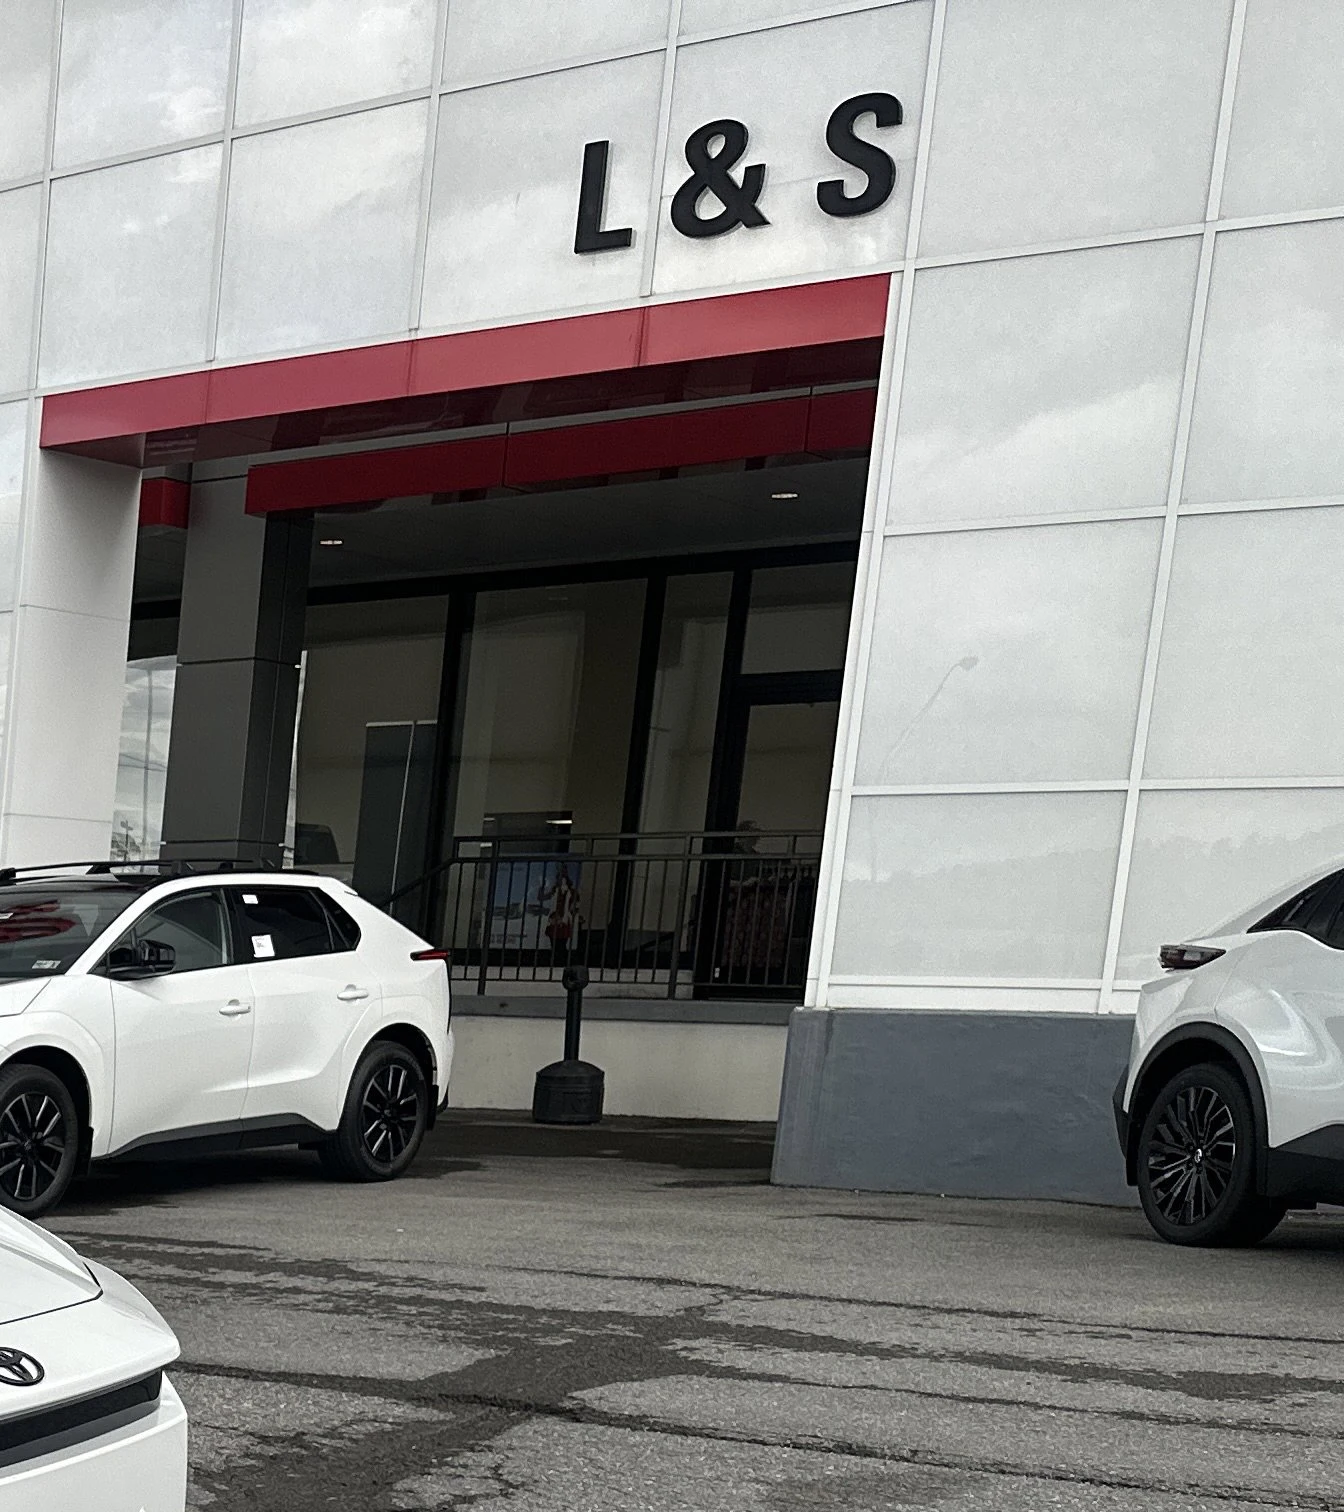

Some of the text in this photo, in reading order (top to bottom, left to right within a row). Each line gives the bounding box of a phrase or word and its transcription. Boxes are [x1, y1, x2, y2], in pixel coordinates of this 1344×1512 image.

[574, 92, 904, 254] L & S
